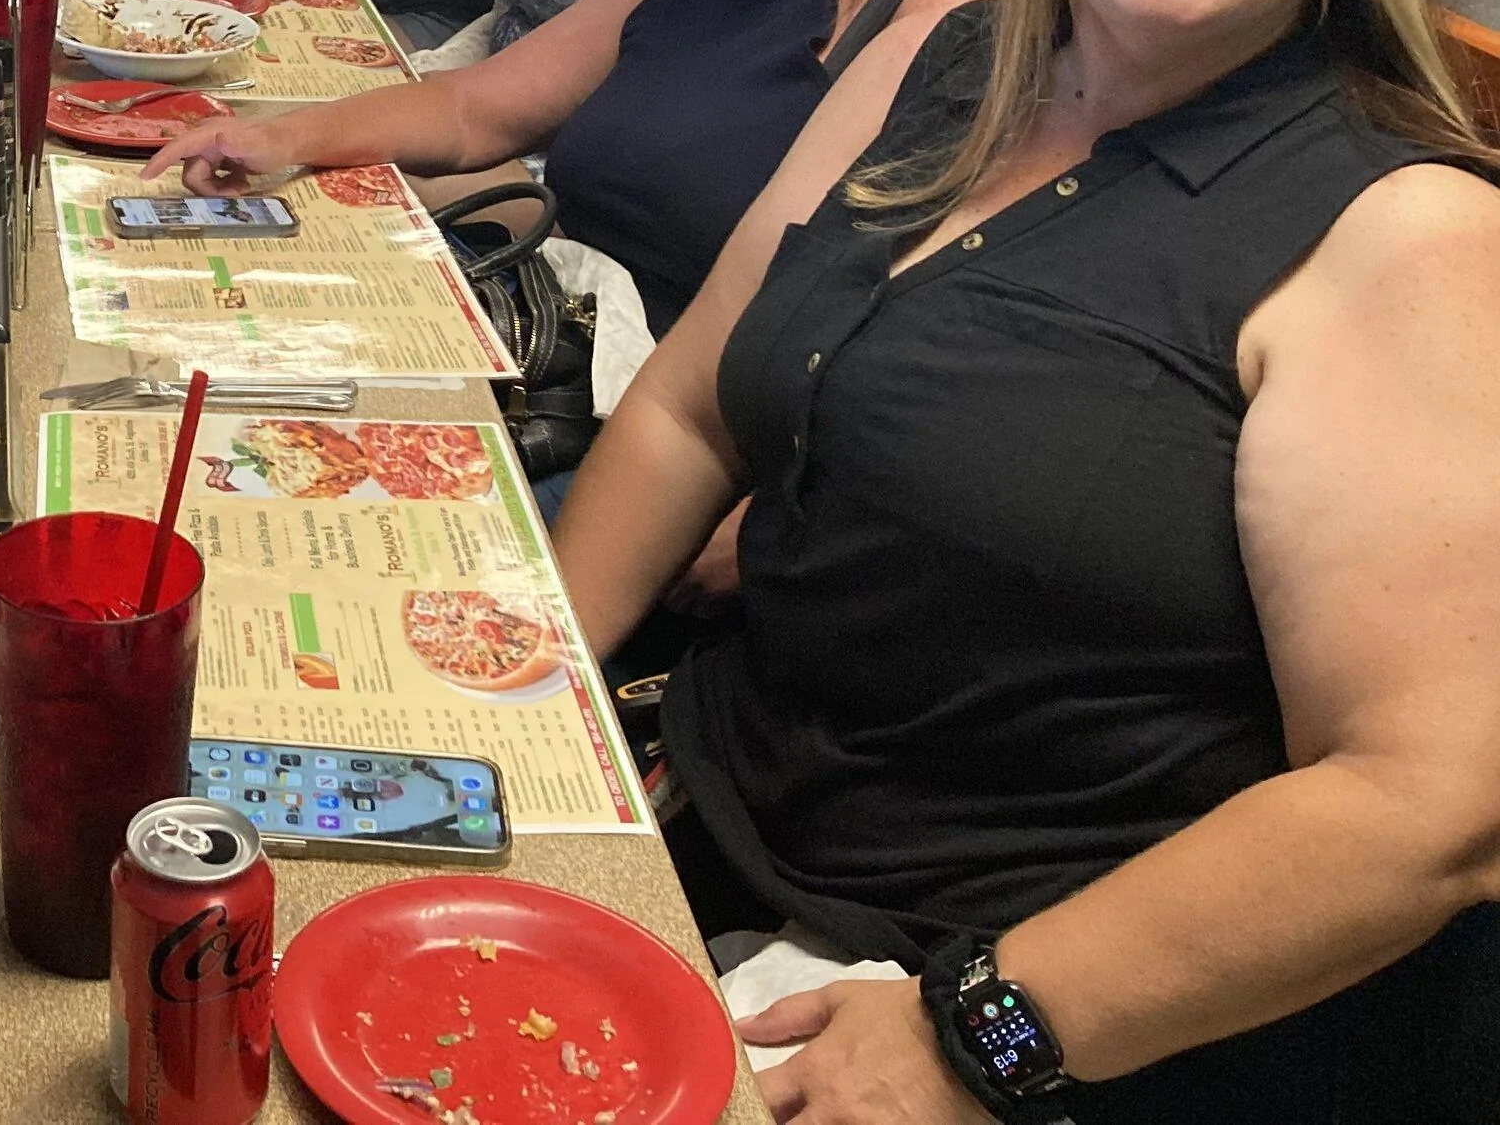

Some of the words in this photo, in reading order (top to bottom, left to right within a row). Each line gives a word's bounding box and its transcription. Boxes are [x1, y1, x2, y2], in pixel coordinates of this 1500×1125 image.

[95, 425, 110, 478] ROMANO'S
[336, 513, 351, 538] Delivery
[377, 514, 405, 572] ROMANO'S
[342, 539, 359, 568] Business
[993, 1049, 1019, 1070] 6:13
[145, 1041, 160, 1124] RECYCLE
